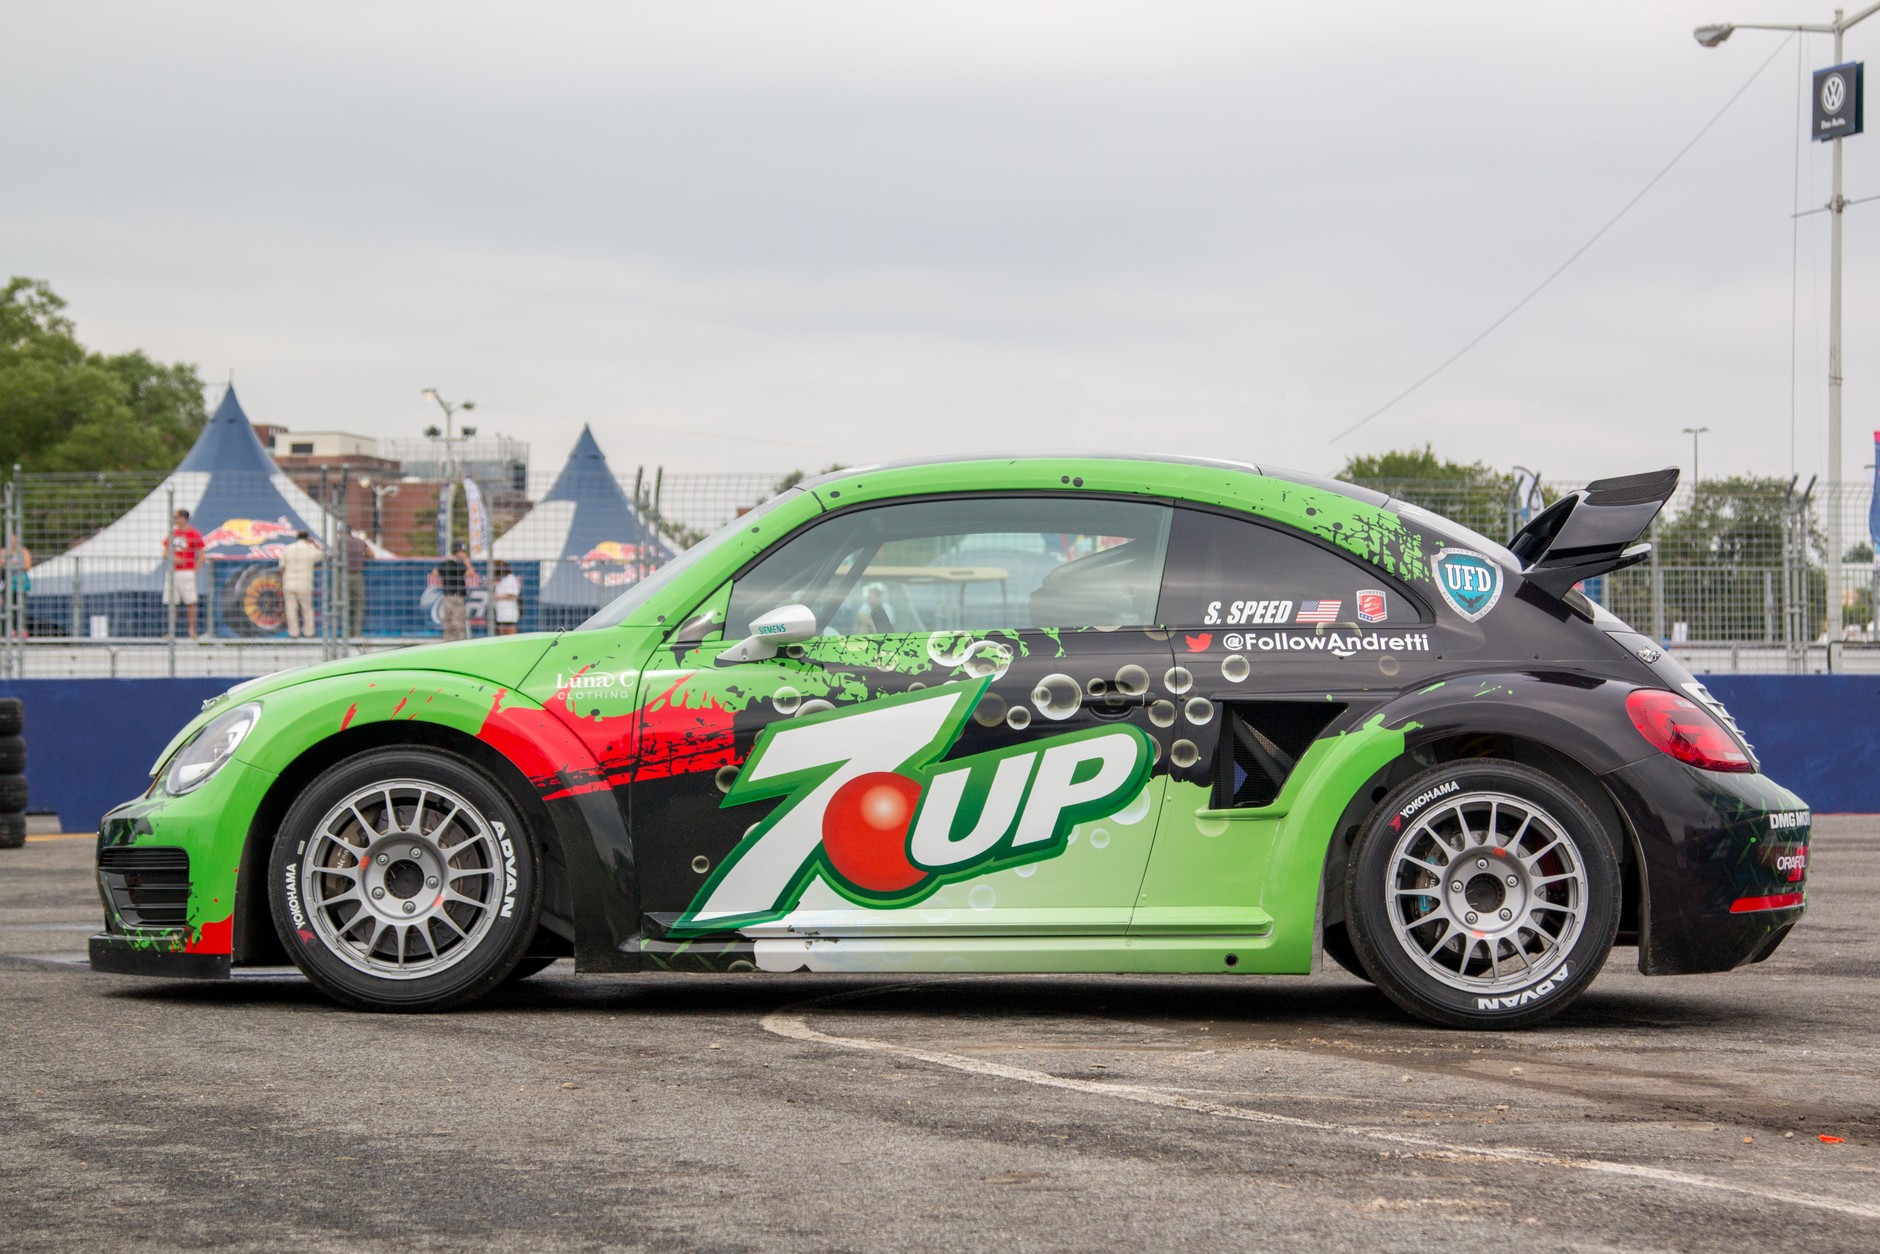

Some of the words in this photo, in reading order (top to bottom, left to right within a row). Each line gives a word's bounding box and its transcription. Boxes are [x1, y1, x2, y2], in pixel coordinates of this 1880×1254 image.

[1444, 563, 1492, 593] UFD
[1203, 601, 1222, 625] S.
[1226, 600, 1293, 625] SPEED
[758, 623, 787, 635] SIEMENS
[1223, 632, 1430, 651] @FollowAndretti
[556, 671, 615, 689] Luna
[619, 669, 637, 688] C
[557, 690, 629, 700] CLOTHING
[1400, 780, 1460, 819] YOKOHAMA
[1770, 813, 1795, 829] DMG
[489, 820, 519, 918] ADVAN
[1777, 855, 1806, 871] ORAFOL
[285, 863, 306, 930] YOKOHAMA
[1478, 963, 1569, 1010] ADVAN
